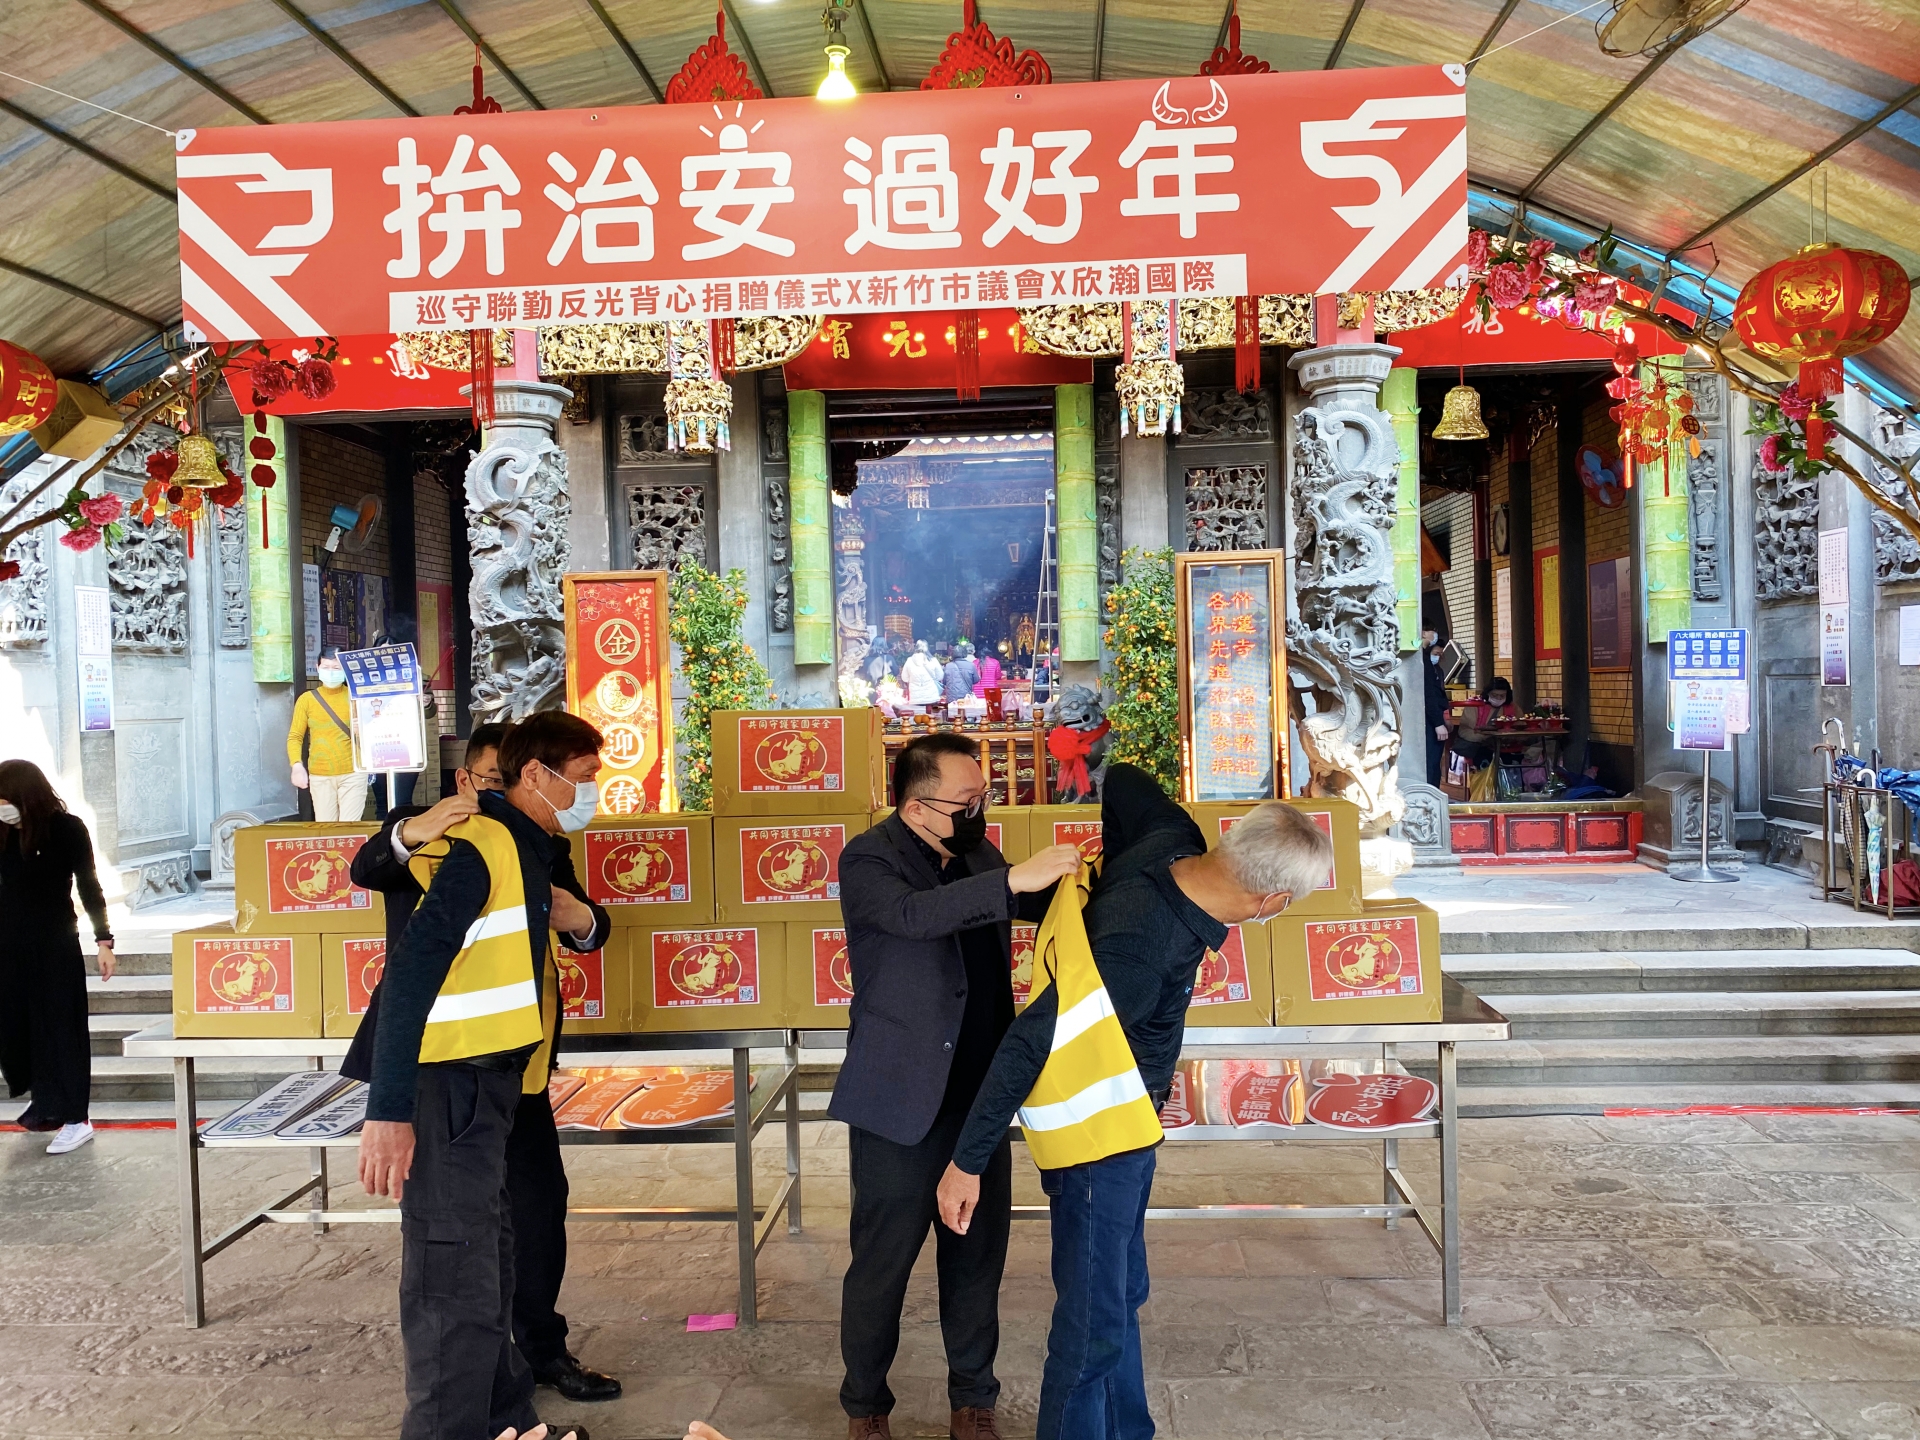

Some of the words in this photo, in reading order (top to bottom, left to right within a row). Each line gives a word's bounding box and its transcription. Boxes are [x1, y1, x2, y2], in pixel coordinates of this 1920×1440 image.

[600, 623, 636, 658] 金
[1230, 591, 1257, 659] 竹蓮寺
[822, 930, 848, 942] 共同
[1330, 1076, 1412, 1125] 愛心相挺
